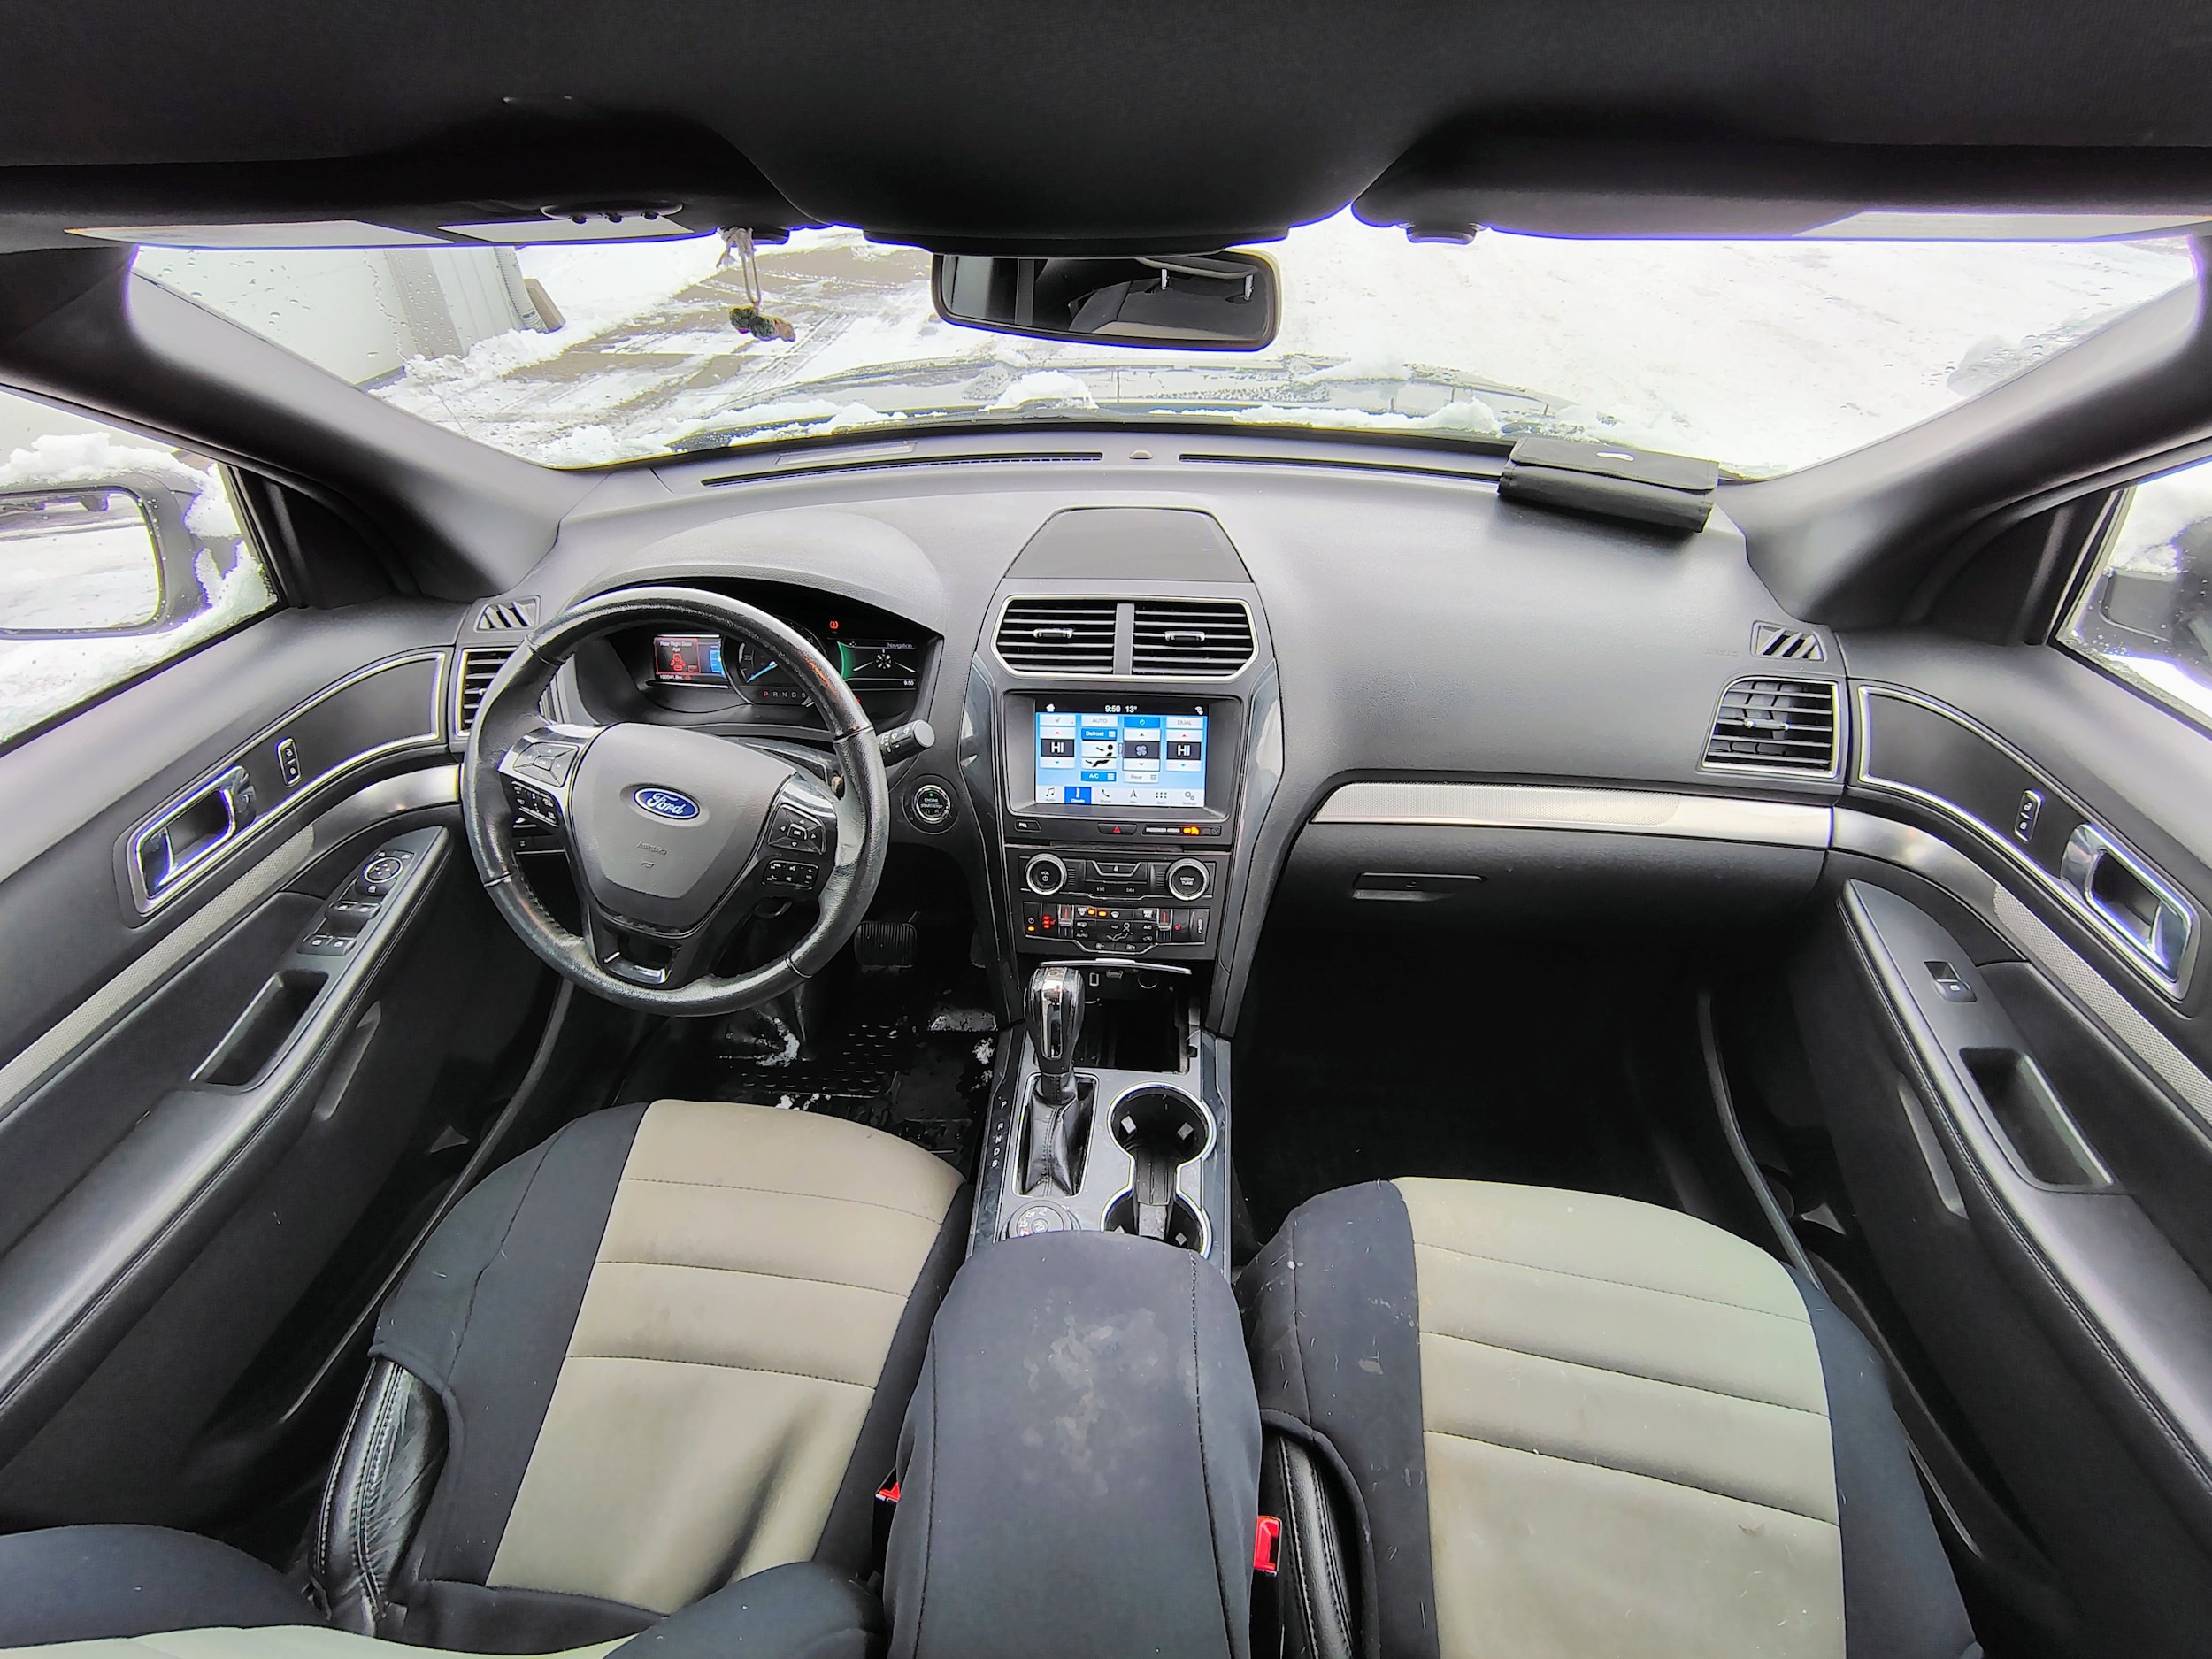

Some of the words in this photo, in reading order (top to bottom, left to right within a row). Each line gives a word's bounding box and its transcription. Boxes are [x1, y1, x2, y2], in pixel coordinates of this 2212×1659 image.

[1104, 704, 1121, 713] 9:50
[1050, 741, 1064, 754] HI
[1177, 744, 1191, 757] HI
[647, 793, 687, 815] Ford
[997, 1122, 1004, 1131] R
[995, 1134, 1002, 1144] N
[993, 1147, 1000, 1156] D
